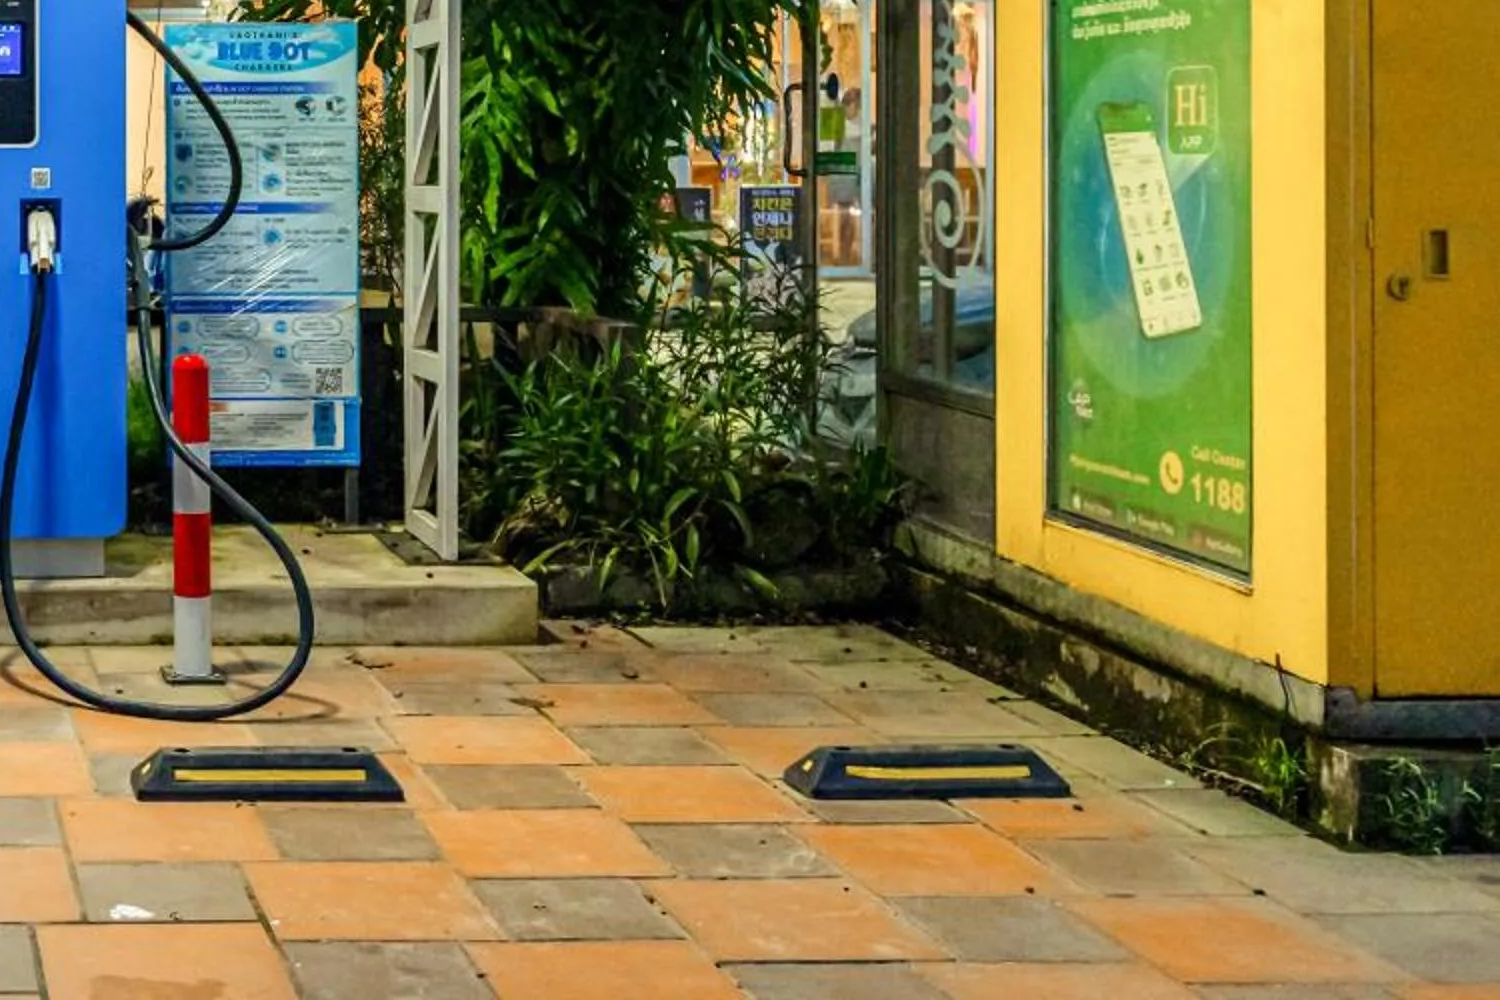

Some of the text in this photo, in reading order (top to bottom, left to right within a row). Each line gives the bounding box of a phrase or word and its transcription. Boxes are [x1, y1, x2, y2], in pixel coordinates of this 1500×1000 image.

[217, 41, 312, 60] BLUE DOT
[1174, 82, 1208, 127] Hi
[1190, 472, 1246, 514] 1188
